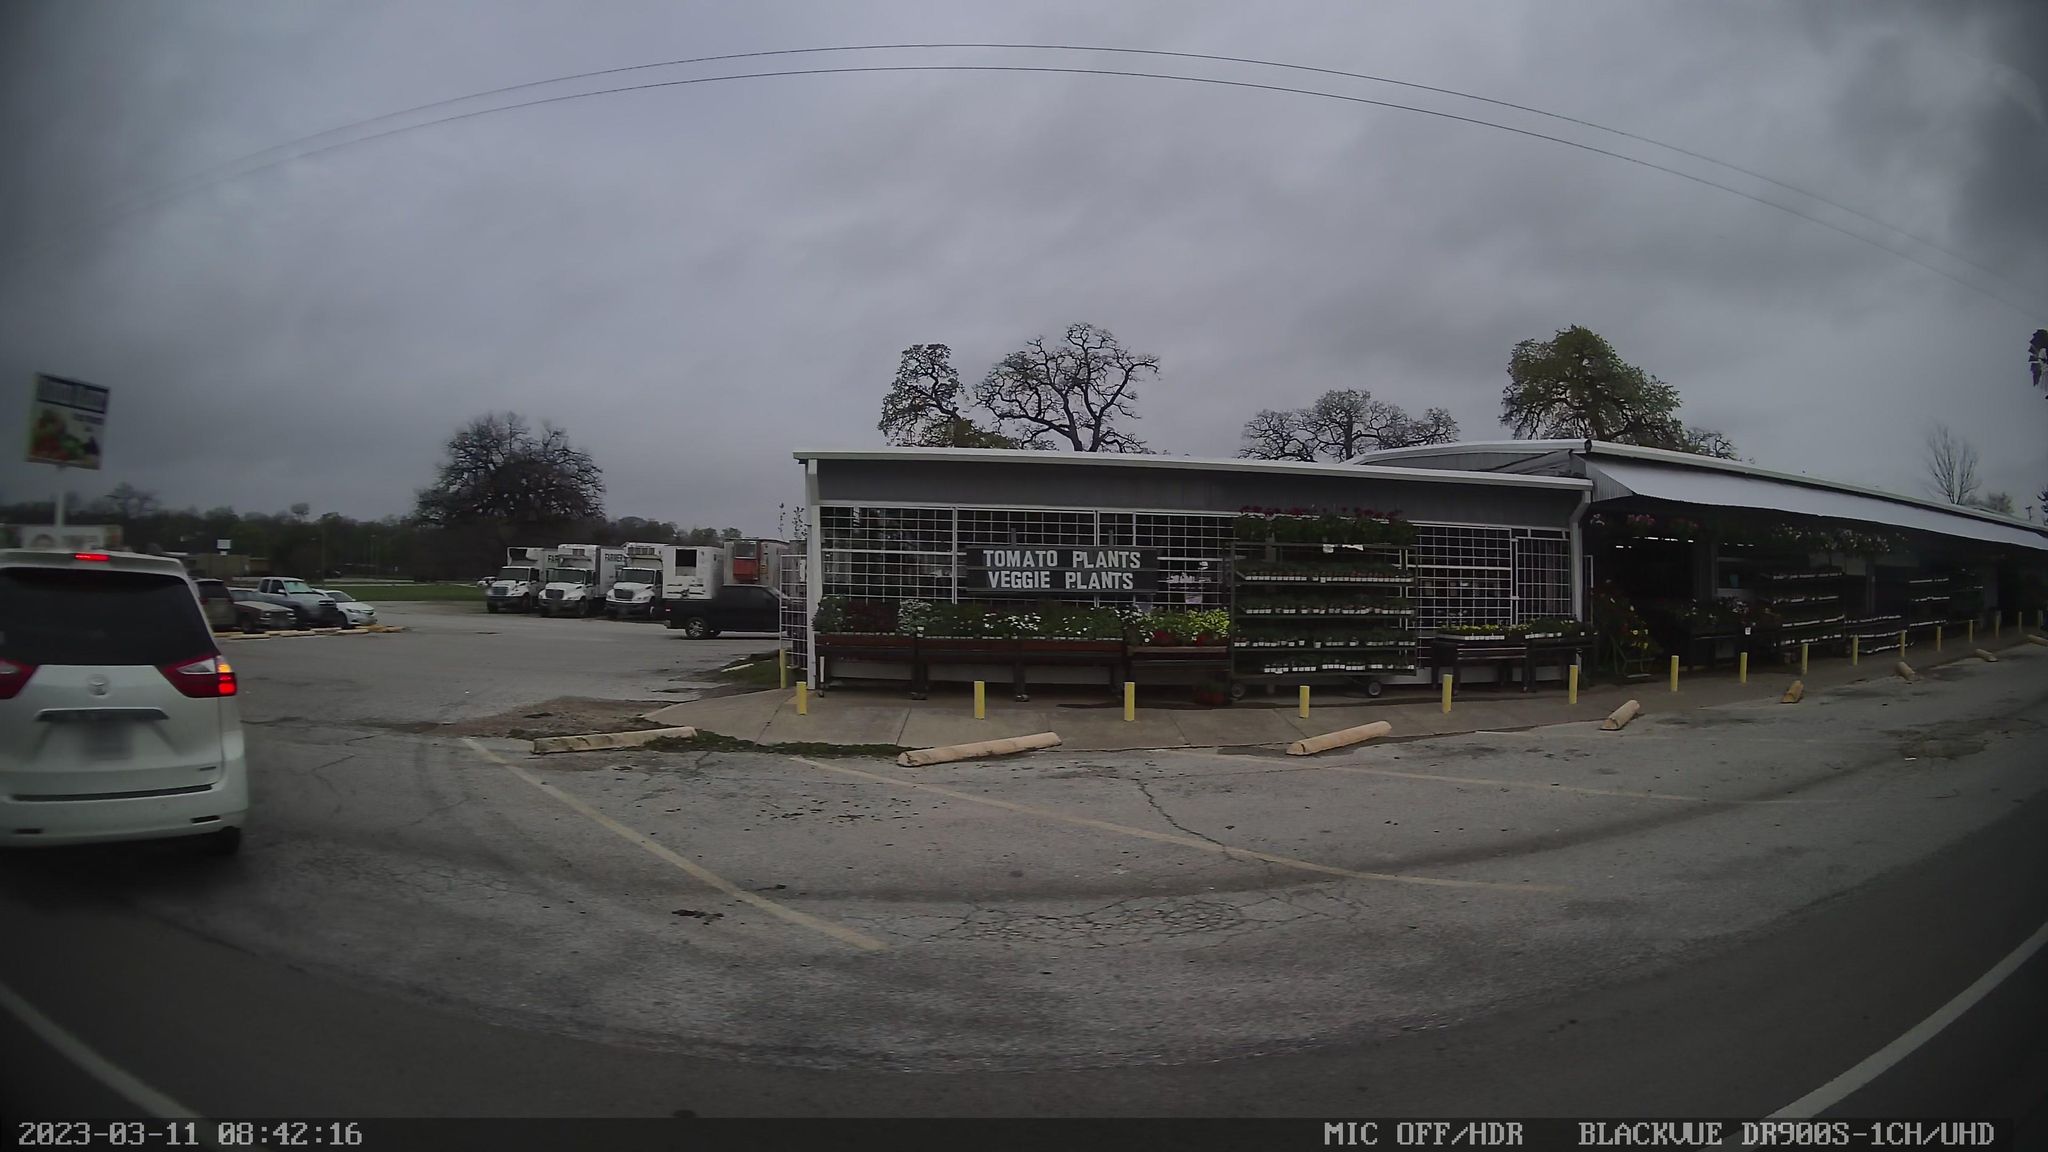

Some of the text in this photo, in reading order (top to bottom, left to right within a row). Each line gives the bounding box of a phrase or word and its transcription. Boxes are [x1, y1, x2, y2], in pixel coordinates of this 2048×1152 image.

[983, 550, 1141, 569] TOMATO PLANTS
[987, 570, 1134, 590] VEGGIE PLANTS
